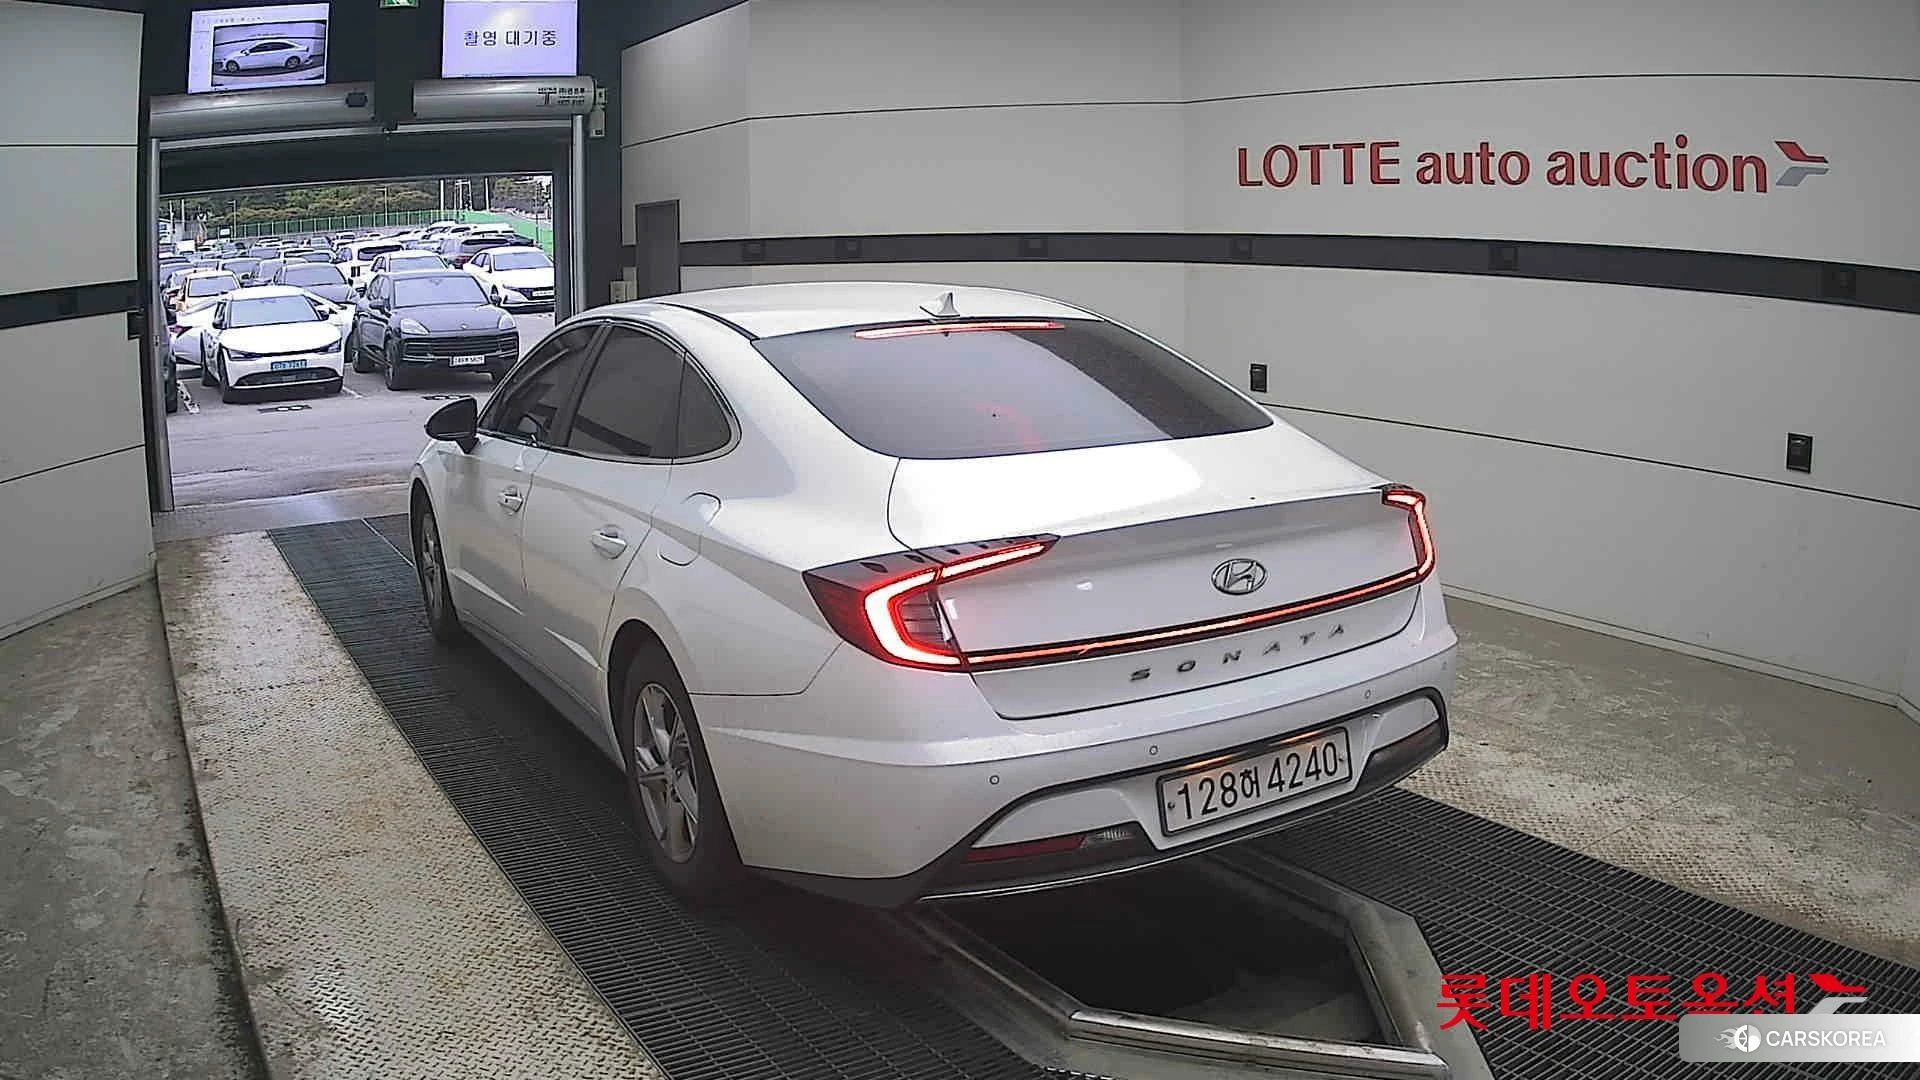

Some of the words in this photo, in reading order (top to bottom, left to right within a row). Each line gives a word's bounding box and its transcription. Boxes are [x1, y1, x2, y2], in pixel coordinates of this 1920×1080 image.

[505, 29, 557, 47] 대기중
[1238, 141, 1401, 187] LOTTE
[1415, 142, 1530, 186] auto
[1546, 133, 1768, 194] auction
[1129, 623, 1344, 682] SONATA
[1267, 740, 1338, 792] 4240
